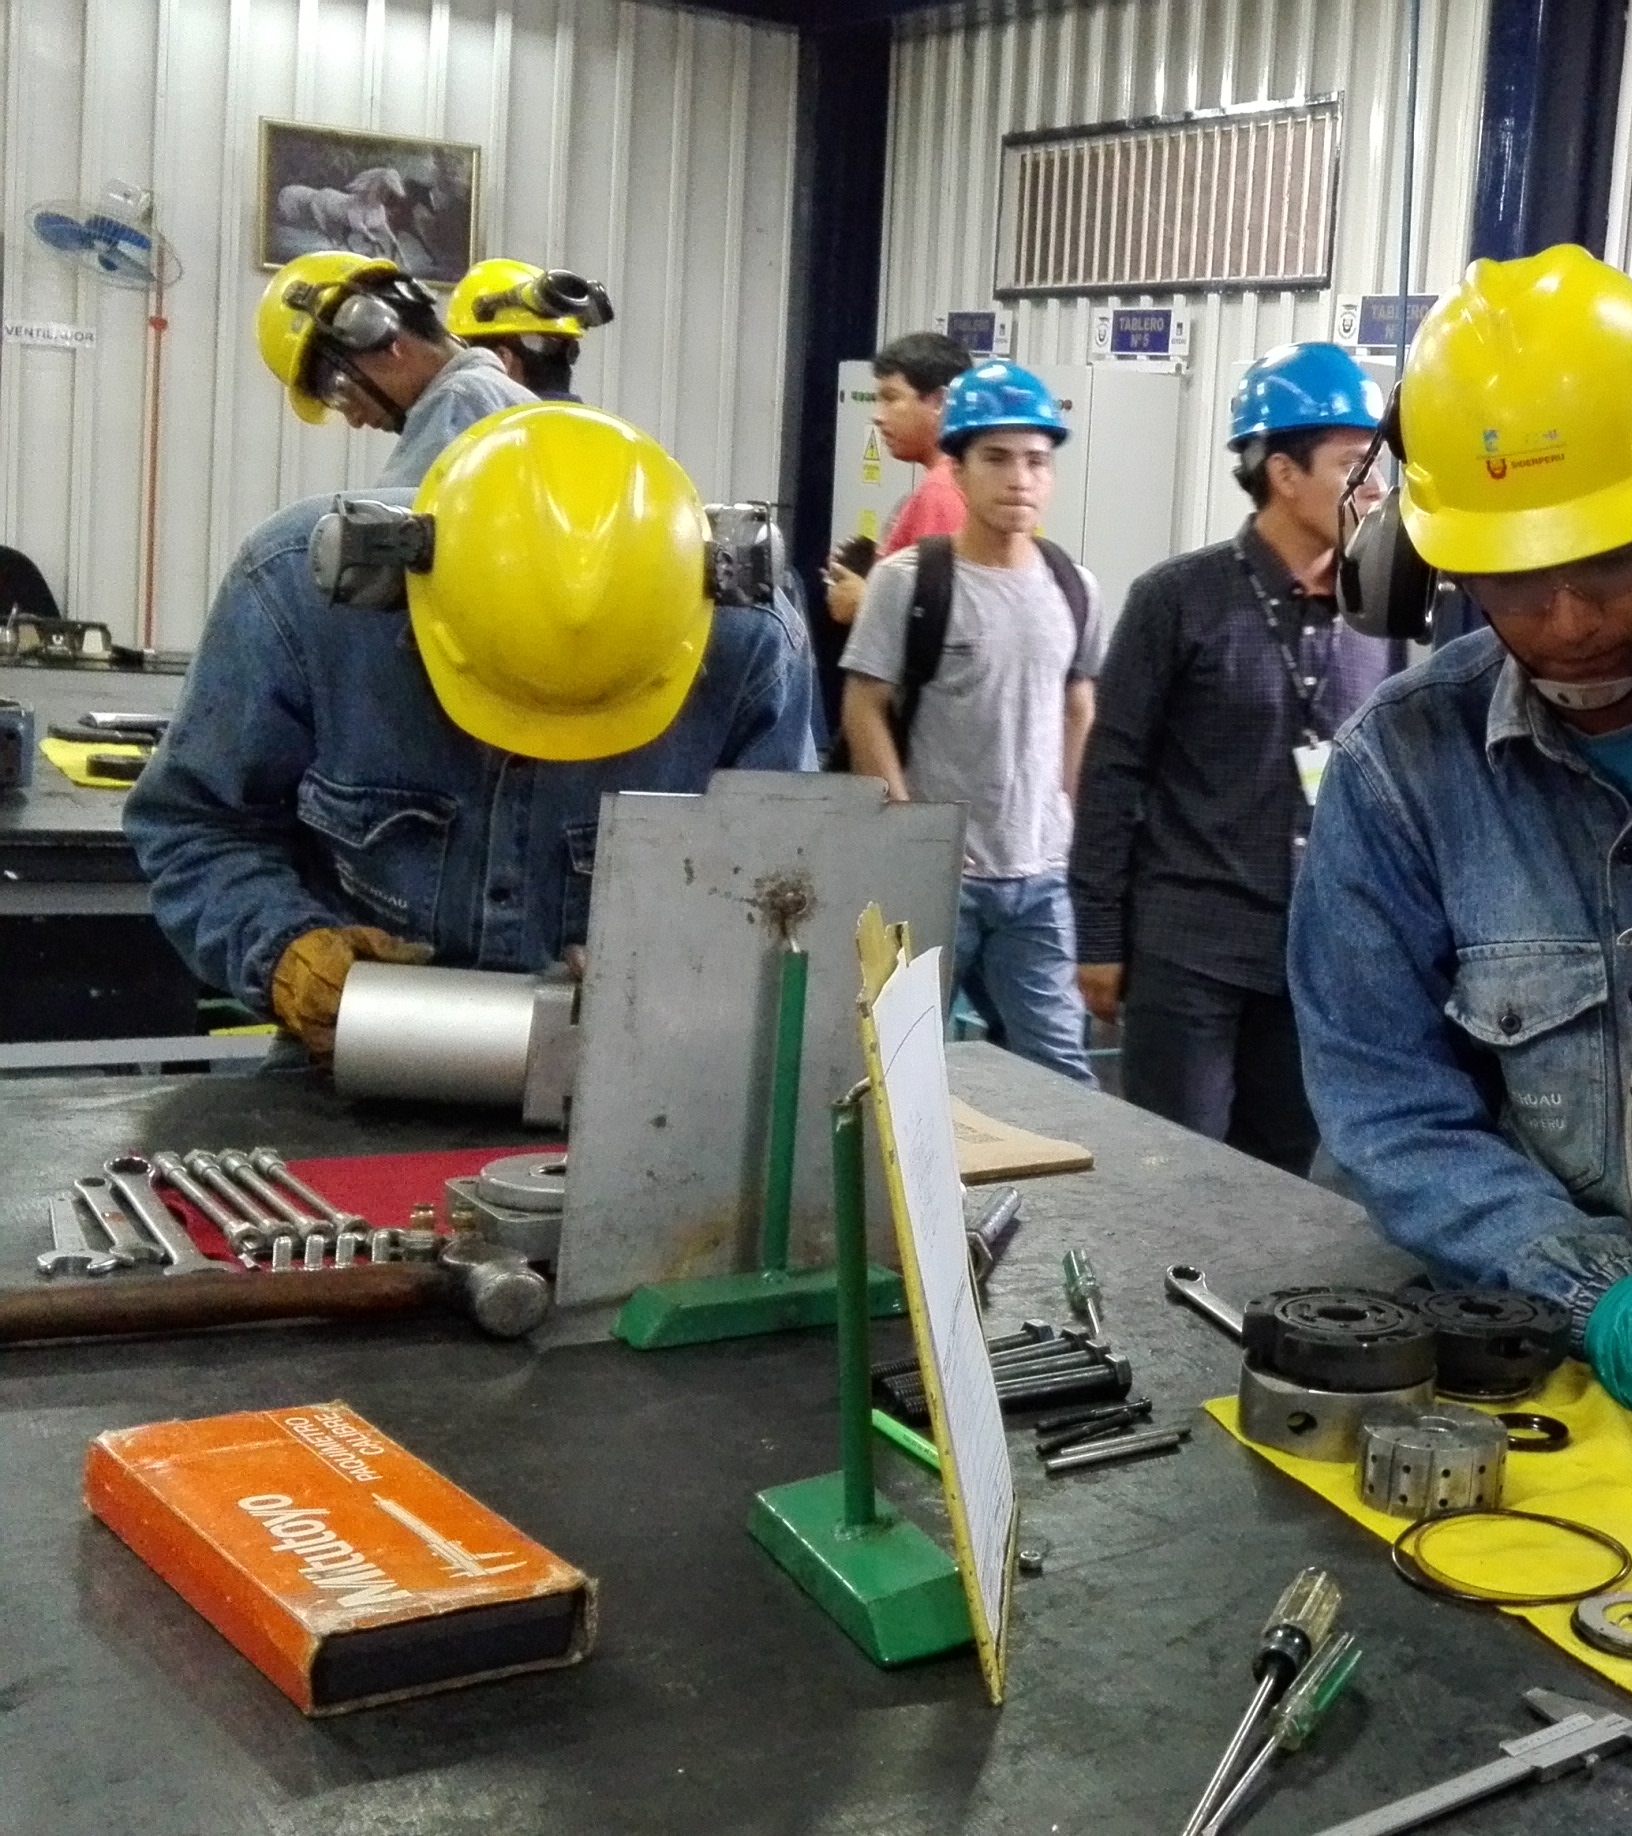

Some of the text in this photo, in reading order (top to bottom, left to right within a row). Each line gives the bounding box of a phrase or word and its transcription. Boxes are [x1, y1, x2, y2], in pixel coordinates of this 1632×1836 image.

[1119, 317, 1165, 331] TABLERO
[314, 1411, 385, 1456] CALIBRE
[237, 1494, 412, 1608] Mitutoyo
